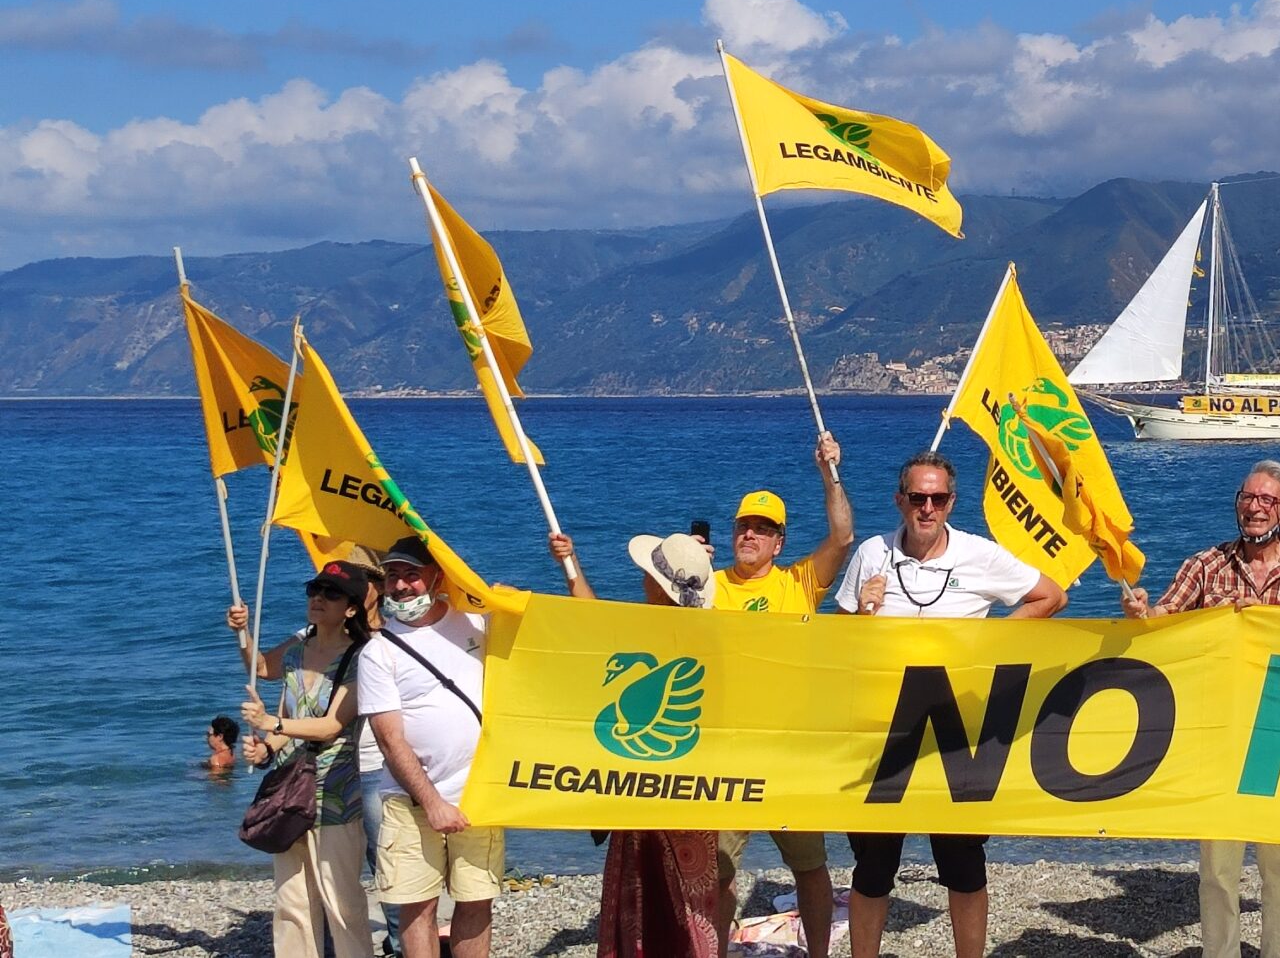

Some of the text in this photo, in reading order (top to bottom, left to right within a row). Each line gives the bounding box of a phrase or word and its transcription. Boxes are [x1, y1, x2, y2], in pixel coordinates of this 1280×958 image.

[779, 142, 939, 204] LEGAMBIENTE
[1209, 398, 1235, 412] NO
[1241, 398, 1263, 413] AL
[319, 468, 408, 524] LEGA
[863, 656, 1176, 805] NO
[508, 760, 766, 802] LEGAMBIENTE
